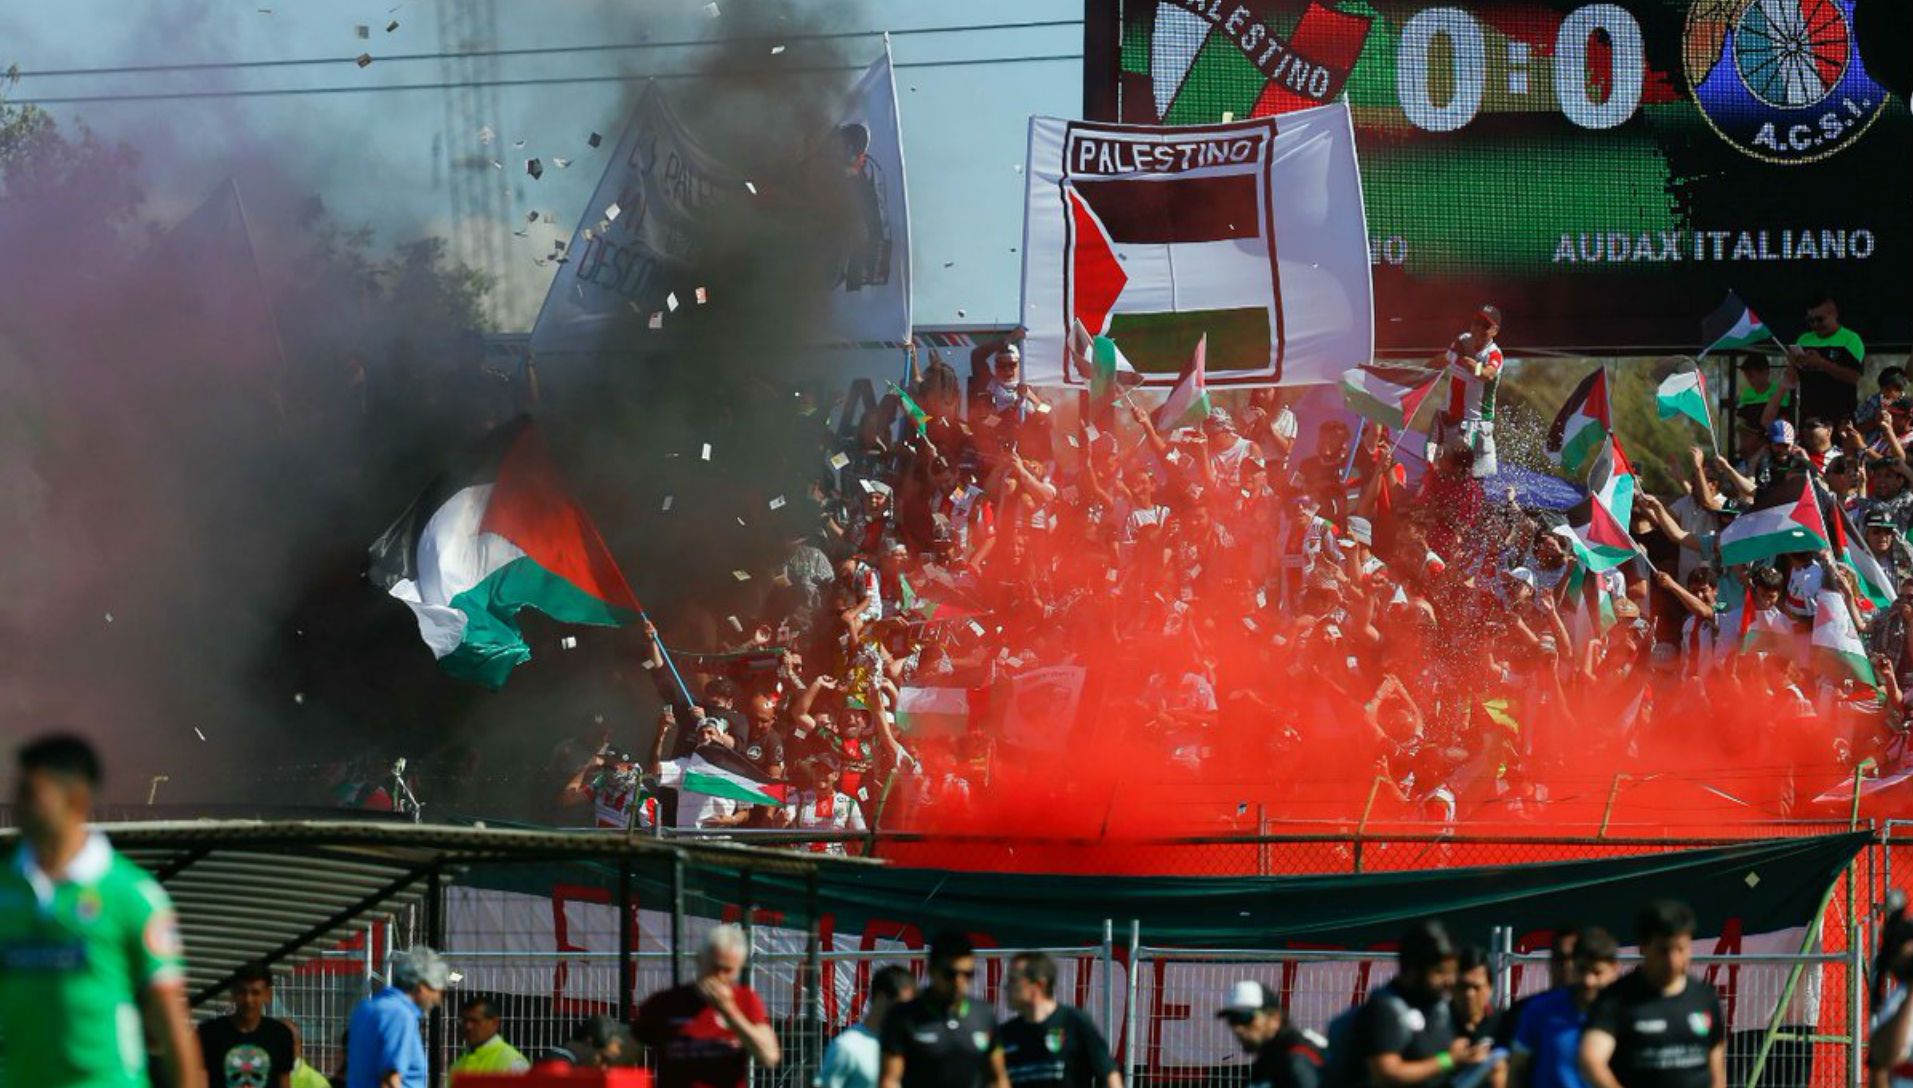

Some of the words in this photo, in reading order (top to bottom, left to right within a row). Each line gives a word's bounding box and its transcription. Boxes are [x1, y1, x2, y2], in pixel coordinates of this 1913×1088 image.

[1079, 140, 1252, 173] PALESTINO
[1551, 230, 1684, 264] AUDAX
[1694, 228, 1876, 261] ITALIANO
